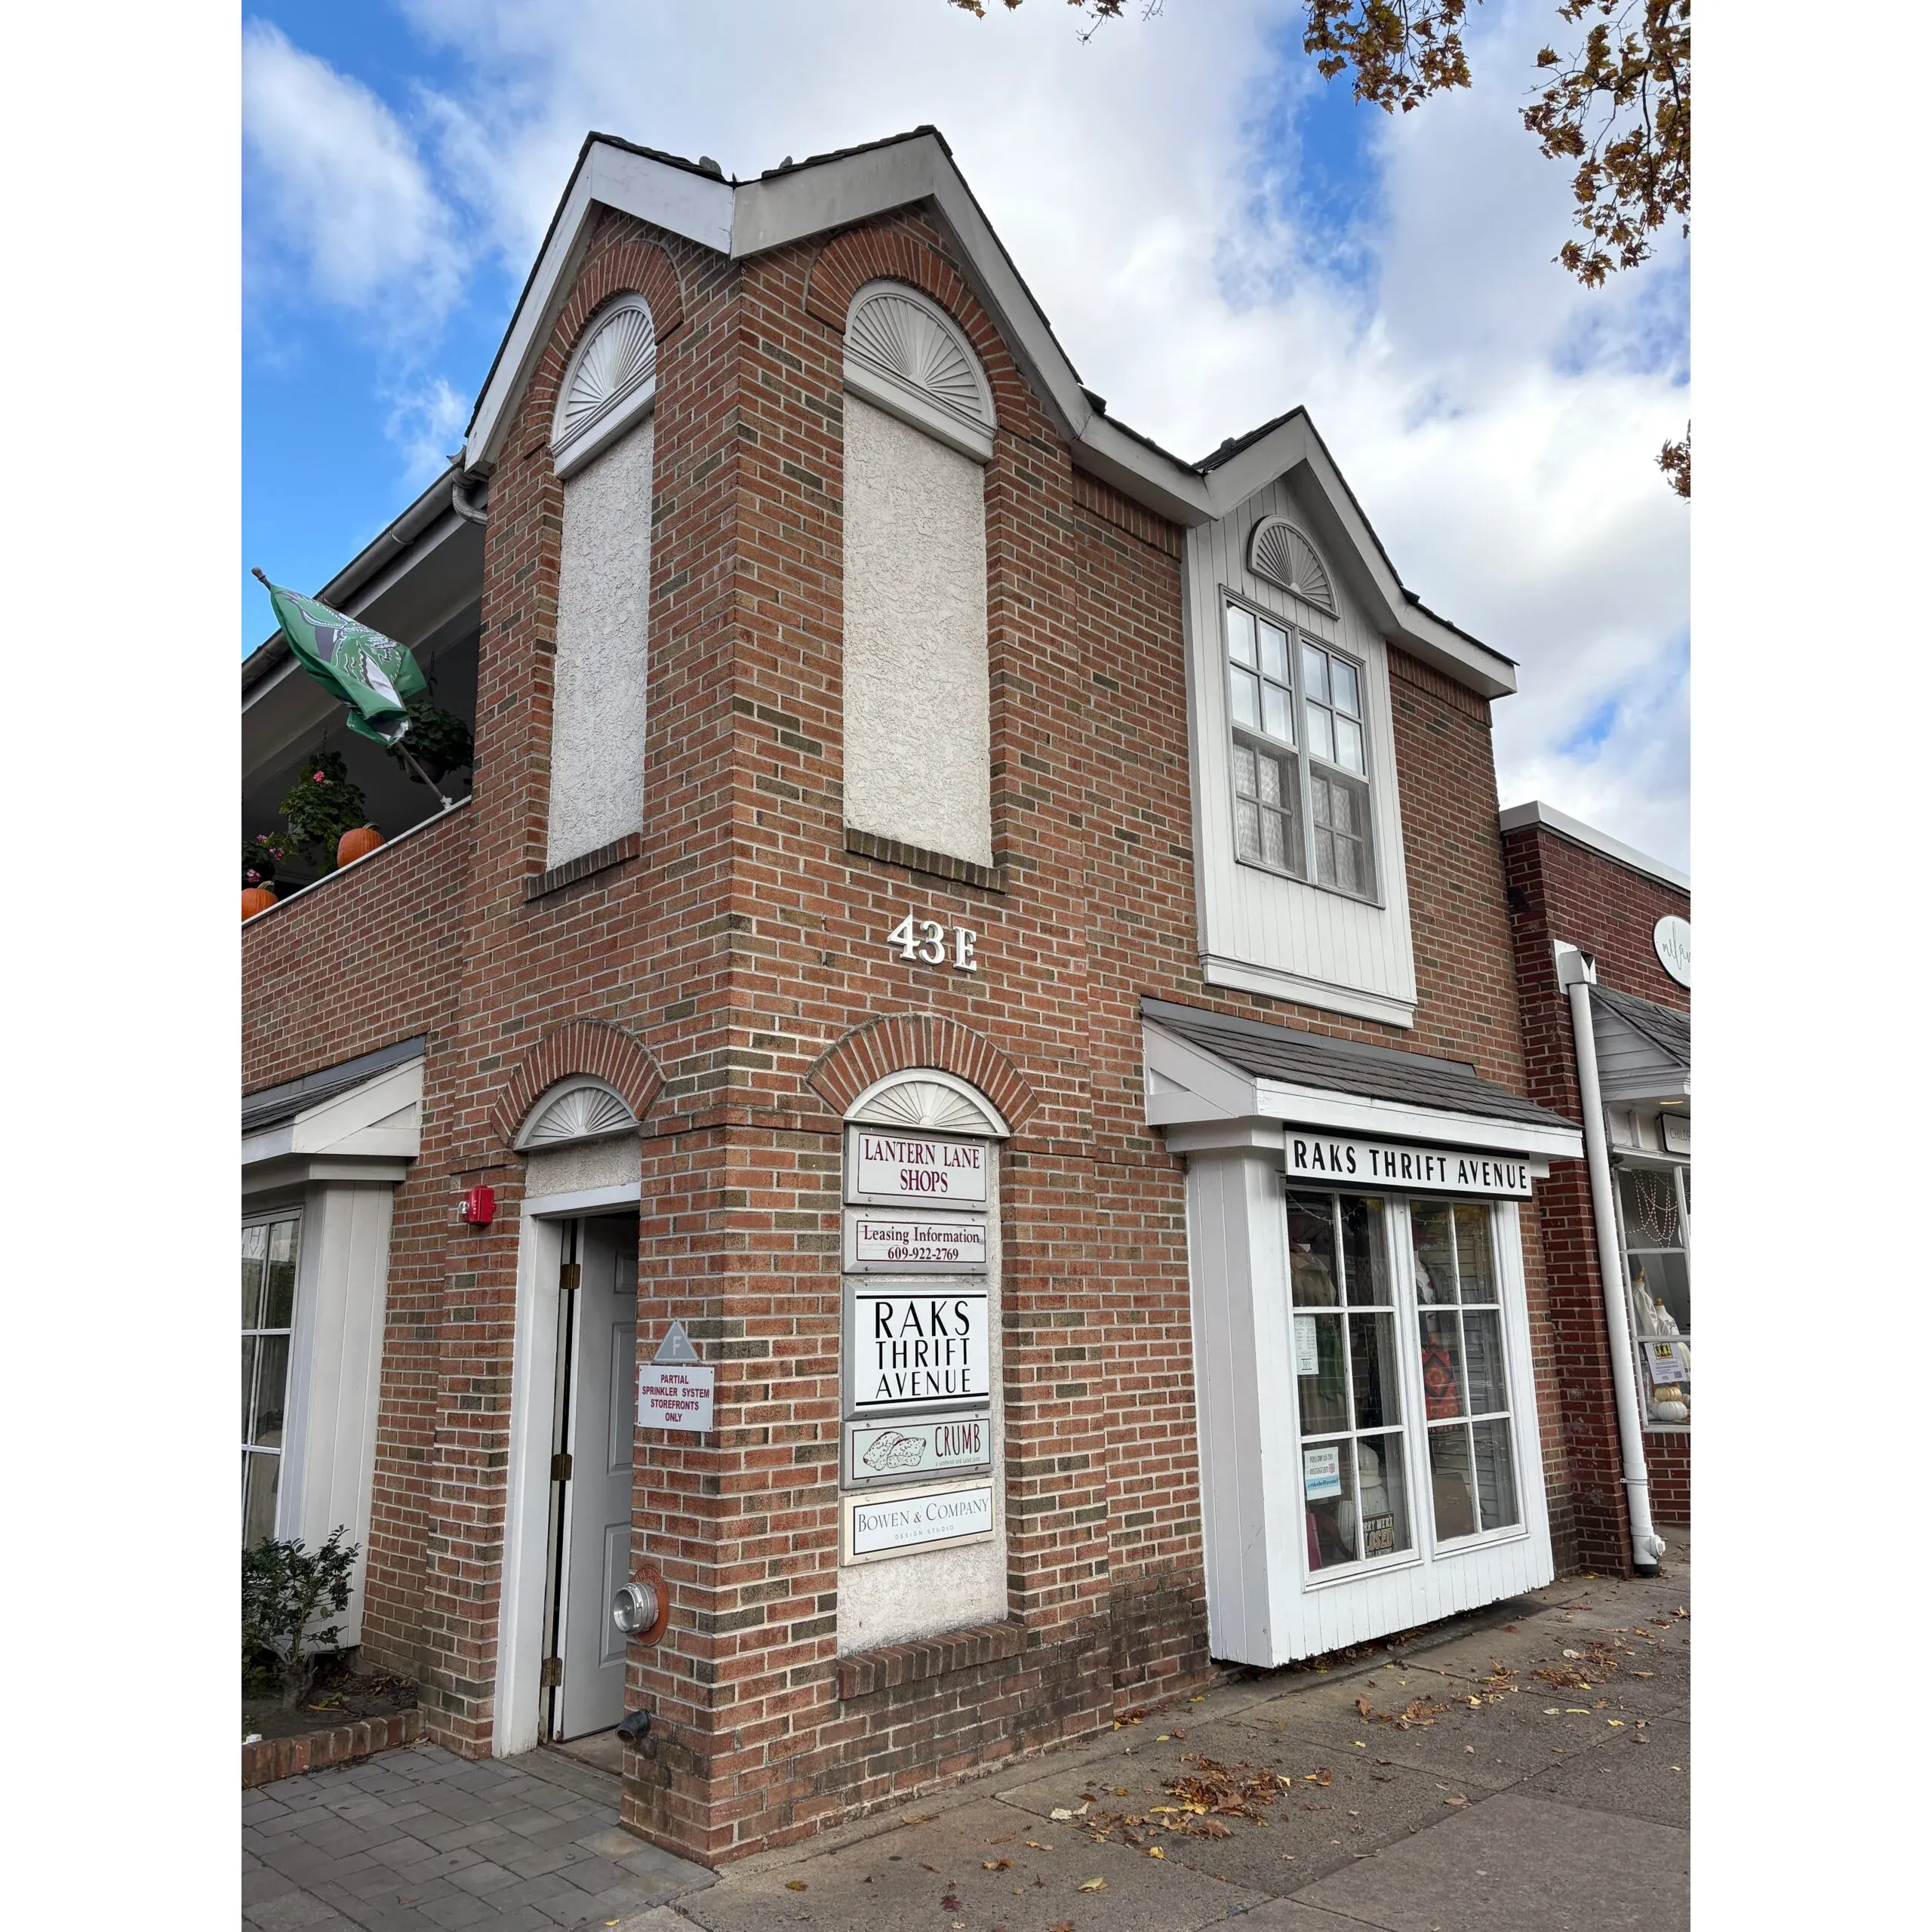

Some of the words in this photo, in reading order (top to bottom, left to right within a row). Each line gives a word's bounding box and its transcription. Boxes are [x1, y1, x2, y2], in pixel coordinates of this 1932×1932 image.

[865, 1139, 935, 1164] LANTERN
[943, 1146, 980, 1169] LANE
[1294, 1140, 1356, 1174] RAKS
[1369, 1149, 1447, 1183] THRIFT
[1458, 1159, 1527, 1189] AVENUE
[900, 1169, 948, 1192] SHOPS
[863, 1225, 909, 1244] Leasing
[914, 1226, 980, 1244] Information
[888, 1247, 959, 1260] 609-922-2769
[875, 1300, 970, 1339] RAKS
[672, 1336, 681, 1355] F
[875, 1338, 970, 1370] THRIFT
[660, 1374, 689, 1384] PARTIAL
[875, 1368, 971, 1399] AVENUE
[642, 1386, 678, 1397] SPRINKLER
[682, 1388, 709, 1398] SYSTEM
[651, 1398, 699, 1411] STOREFRONTS
[665, 1412, 682, 1423] ONLY
[935, 1423, 980, 1457] CRUMB
[858, 1510, 909, 1533] BOWEN
[914, 1512, 922, 1524] &
[926, 1498, 989, 1521] COMPANY
[895, 1531, 923, 1540] DESIGN
[927, 1524, 954, 1534] STUDIO
[1363, 1520, 1376, 1533] RRY
[1364, 1528, 1393, 1551] LOSED
